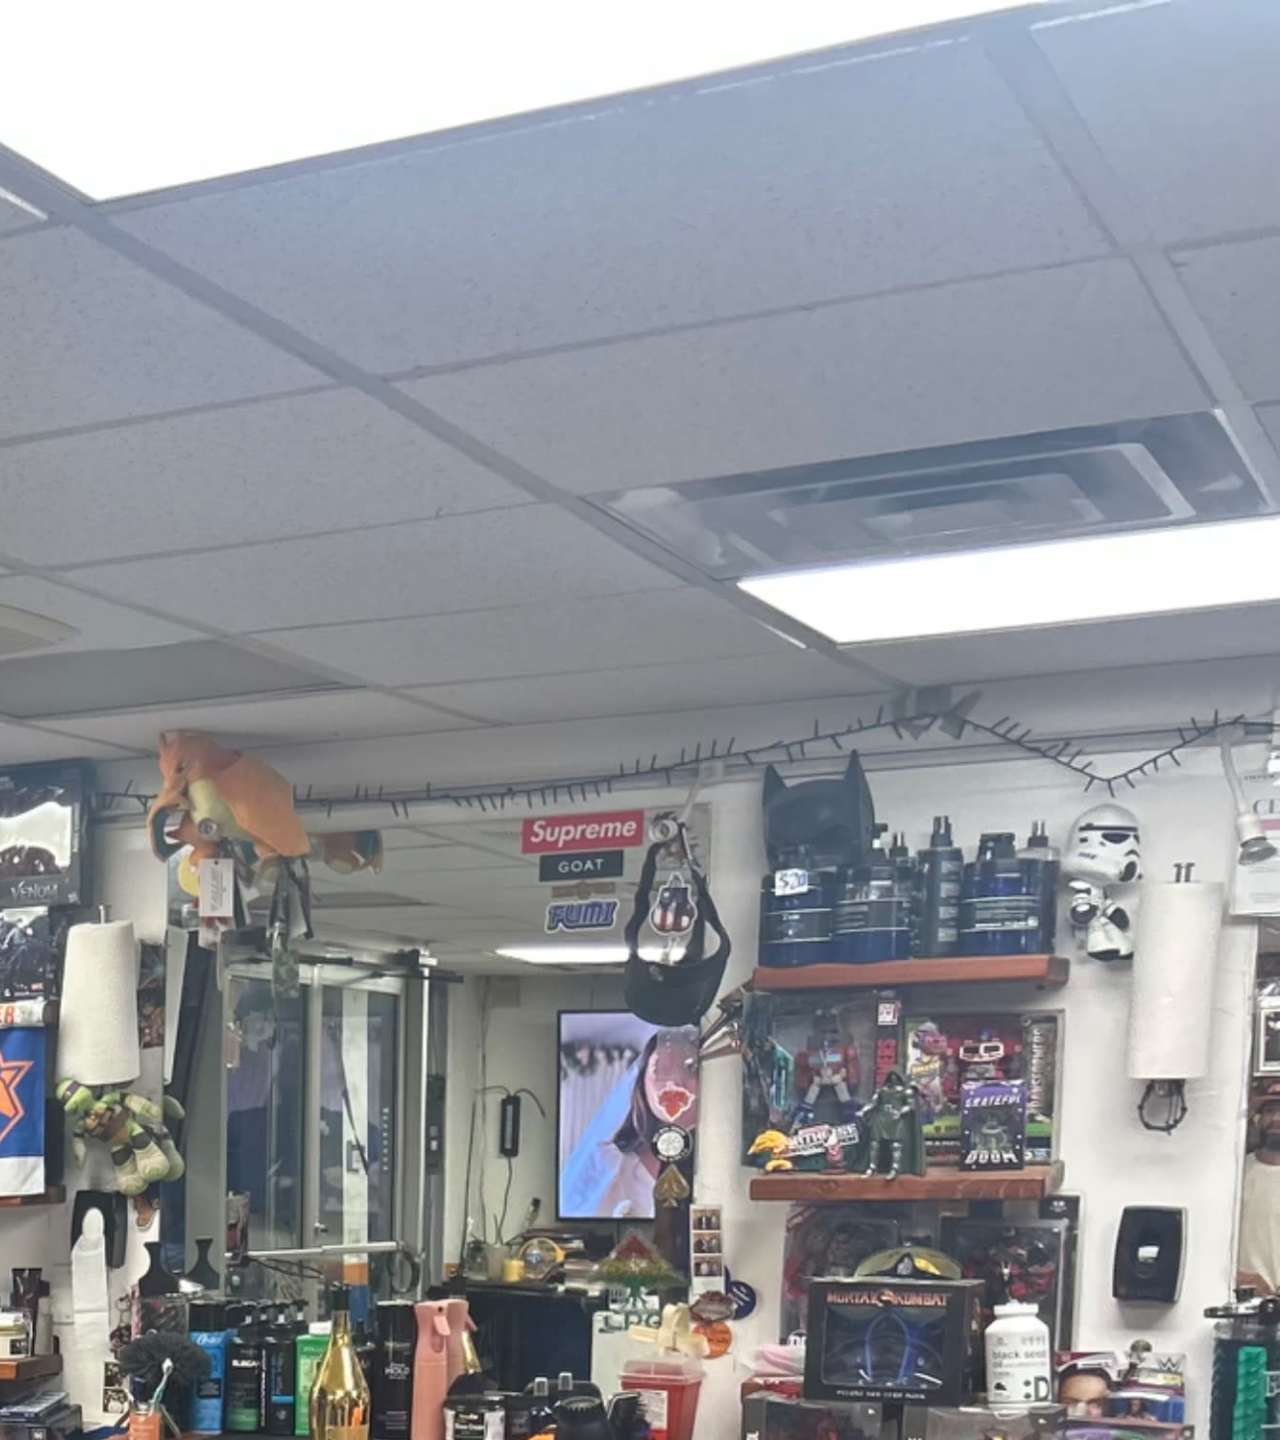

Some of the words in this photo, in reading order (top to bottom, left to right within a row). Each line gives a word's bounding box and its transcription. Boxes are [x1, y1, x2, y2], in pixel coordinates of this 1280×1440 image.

[531, 820, 637, 848] Supreme
[558, 859, 604, 873] GOAT
[11, 880, 57, 898] VENOM
[965, 1150, 1019, 1164] DOOM
[891, 1293, 948, 1306] KOMBAT
[992, 1350, 1019, 1360] black
